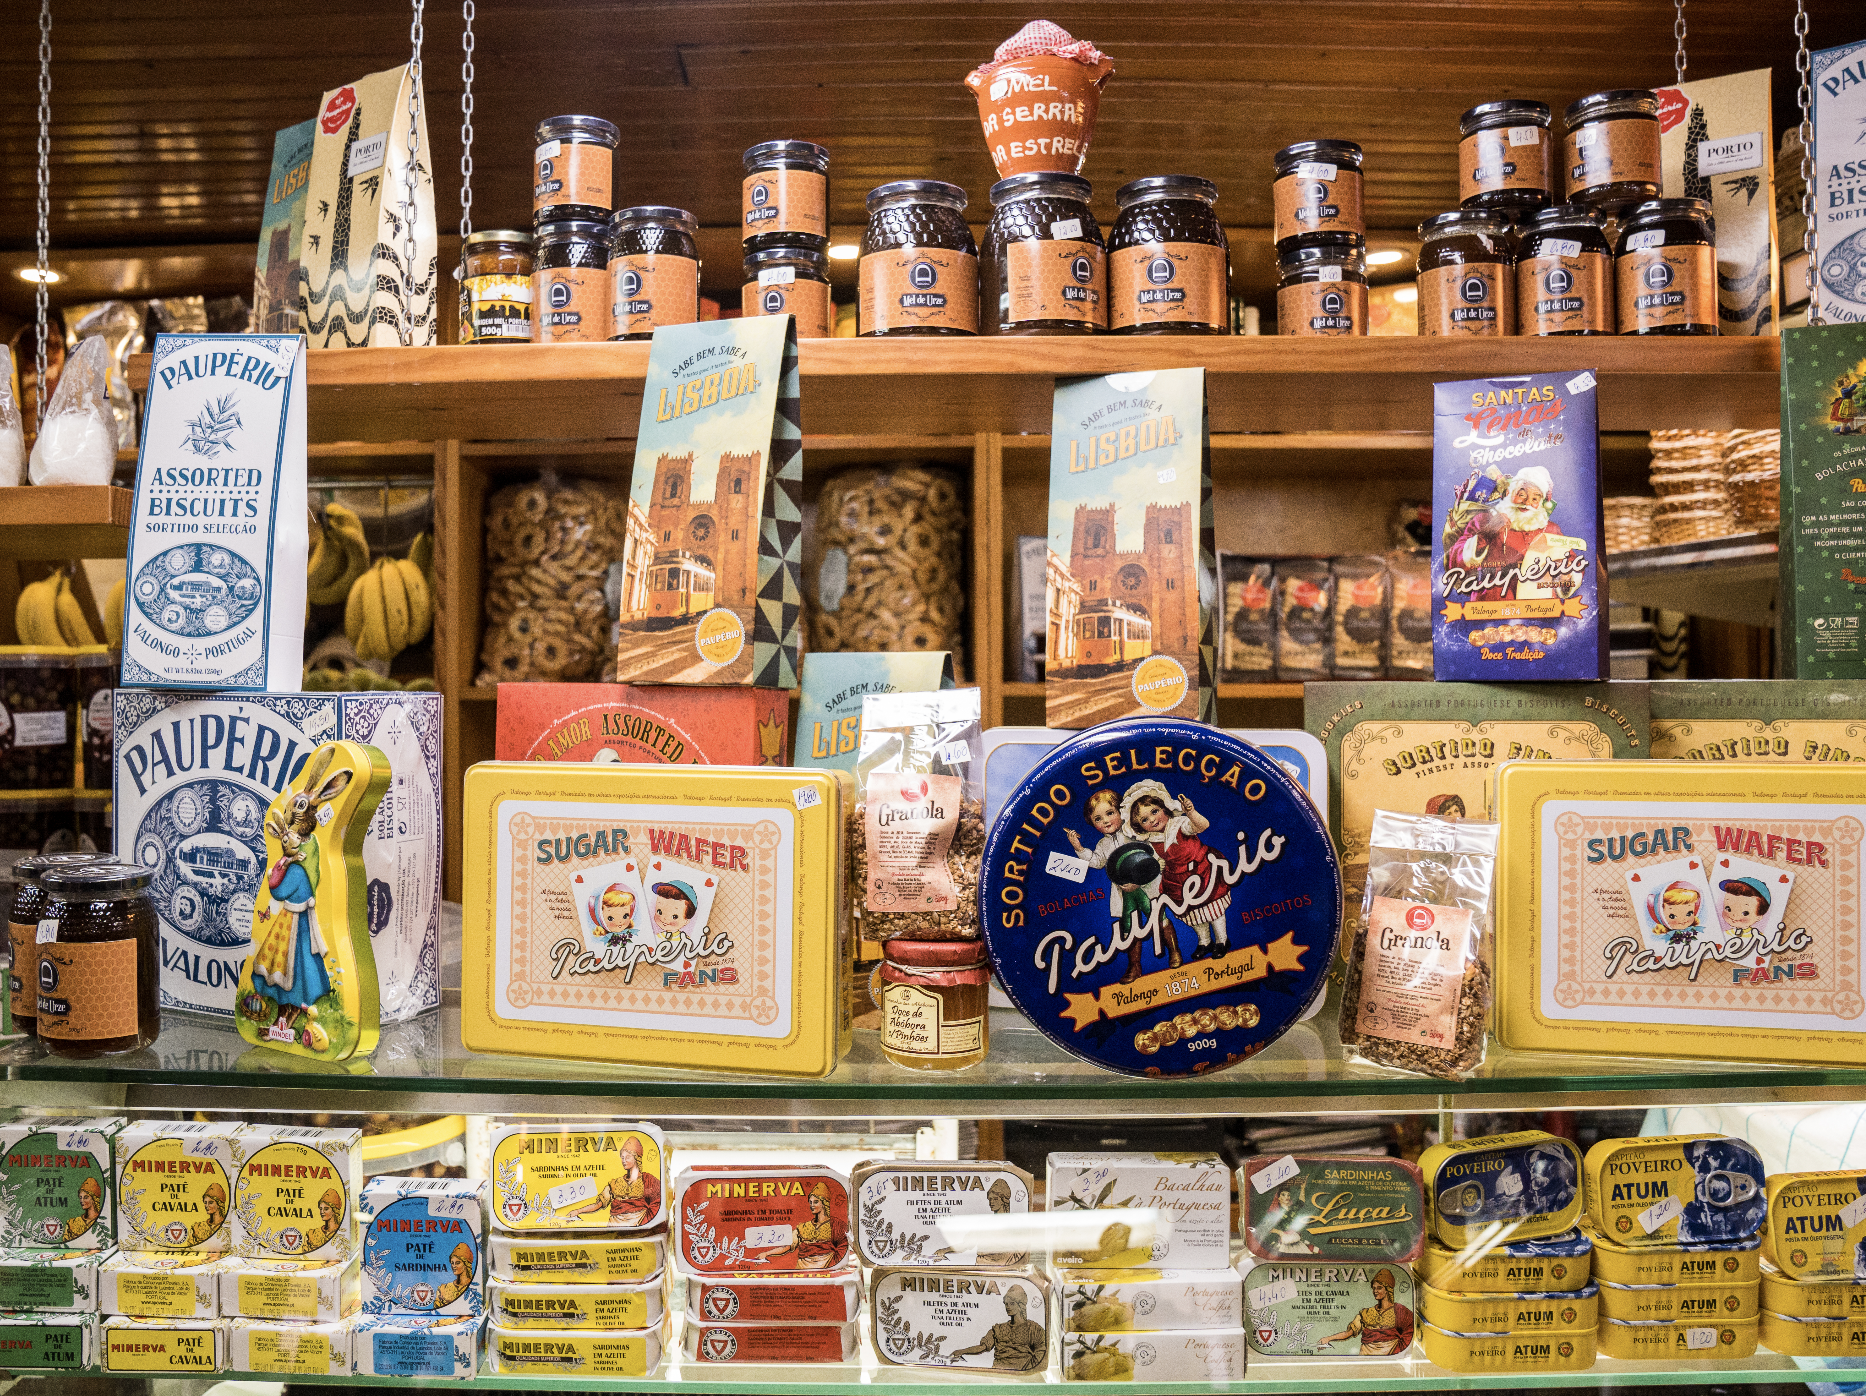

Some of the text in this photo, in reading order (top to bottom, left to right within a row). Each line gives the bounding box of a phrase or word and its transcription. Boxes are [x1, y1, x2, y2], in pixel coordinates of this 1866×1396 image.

[1008, 75, 1058, 97] MEL
[984, 103, 1075, 138] DA SERRA
[355, 141, 382, 158] PORTO
[992, 145, 1007, 167] DA
[1707, 141, 1754, 158] PORTO
[903, 295, 944, 306] Mel de Urze
[1140, 289, 1182, 302] Mel de Urze
[1638, 293, 1681, 309] Mel de Urze
[1454, 308, 1495, 320] Mel de Urze
[1539, 300, 1580, 313] Mel de Urze
[1313, 317, 1350, 329] Mel de Urze
[481, 327, 502, 336] 500g
[159, 349, 288, 391] PAUPÉRIO
[672, 345, 747, 379] SABE BEM. SABE A
[656, 363, 761, 423] LISBOA
[1472, 386, 1555, 408] SANTAS
[1081, 398, 1163, 430] SABE BEM. SABE A
[1453, 398, 1566, 448] Lenas
[1518, 428, 1532, 439] de
[1069, 415, 1182, 474] LISBOA
[1469, 432, 1564, 468] Chocolate
[151, 467, 262, 487] ASSORTED
[148, 497, 258, 518] BISCUITS
[146, 521, 257, 535] SORTIDO SELECÇÃO
[1442, 551, 1589, 598] Paupério
[1471, 604, 1555, 617] Valongo 1874 Portugal
[133, 623, 257, 660] VALONGO PORTUGAL
[700, 630, 740, 647] PAUPÉRIO
[1481, 646, 1545, 661] Doce Tradição
[1137, 674, 1183, 693] PAUPÉRIO
[1584, 697, 1639, 749] BISCUITS
[547, 713, 685, 763] AMOR ASSORTED
[604, 739, 637, 748] ASSORTED
[1382, 737, 1495, 776] SORTIDO
[1415, 763, 1455, 779] FINEST
[878, 800, 945, 827] Granola
[1001, 746, 1267, 928] SORTIDO SELECÇÃO
[537, 828, 749, 872] SUGAR WAFER
[1586, 825, 1828, 867] SUGAR WAFER
[1034, 827, 1286, 994] Paupério
[1038, 888, 1106, 918] BOLACHAS
[1241, 894, 1312, 924] BISCOITOS
[1380, 926, 1450, 951] Granola
[550, 926, 734, 983] Paupério
[1604, 921, 1812, 982] Paupério
[663, 967, 737, 987] FANS
[1169, 970, 1189, 981] DESDE
[1732, 962, 1817, 985] FANS
[1111, 959, 1255, 1008] Valongo 1874 Portugal
[49, 1001, 66, 1013] Urze
[892, 1006, 923, 1017] Doce de
[890, 1017, 926, 1030] Abóbora
[271, 1030, 292, 1040] WINDEL
[1188, 1038, 1217, 1052] 900g
[296, 1146, 308, 1156] 75g
[518, 1136, 617, 1155] MINERVA
[8, 1154, 91, 1169] MINERVA
[132, 1160, 215, 1174] MINERVA
[530, 1165, 569, 1173] SARDINHAS
[1446, 1159, 1505, 1179] POVEIRO
[1610, 1159, 1682, 1175] POVEIRO
[248, 1163, 331, 1180] MINERVA
[1325, 1170, 1392, 1180] SARDINHAS
[37, 1176, 65, 1188] PATÊ
[160, 1182, 189, 1193] PATÊ
[1154, 1170, 1225, 1192] Bacalhau
[276, 1187, 305, 1199] PATÊ
[558, 1184, 586, 1205] 3.30
[707, 1181, 806, 1198] MINERVA
[1611, 1181, 1668, 1201] ATUM
[34, 1197, 68, 1208] ATUM
[152, 1202, 199, 1213] CAVALA
[1782, 1193, 1857, 1209] POVEIRO
[267, 1206, 314, 1219] CAVALA
[1147, 1195, 1225, 1224] Portuguesa
[377, 1218, 463, 1234] MINERVA
[1785, 1215, 1844, 1234] ATUM
[406, 1242, 436, 1254] PATÊ
[516, 1249, 590, 1263] MINERVA
[605, 1246, 642, 1254] SARDINHAS
[394, 1262, 448, 1273] SARDINHA
[1506, 1267, 1544, 1278] ATUM
[1681, 1260, 1716, 1272] ATUM
[1268, 1267, 1370, 1283] MINERVA
[1462, 1271, 1499, 1279] POVEIRO
[900, 1276, 1001, 1295] MINERVA
[505, 1298, 578, 1311] MINERVA
[923, 1300, 948, 1308] FILETES
[1681, 1299, 1717, 1310] ATUM
[1516, 1311, 1553, 1322] ATUM
[111, 1343, 166, 1353] MINERVA
[177, 1336, 204, 1347] PATÊ
[502, 1340, 577, 1355] MINERVA
[43, 1351, 75, 1362] ATUM
[605, 1351, 627, 1359] AZEITE
[1514, 1345, 1551, 1356] ATUM
[169, 1354, 213, 1365] CAVALA
